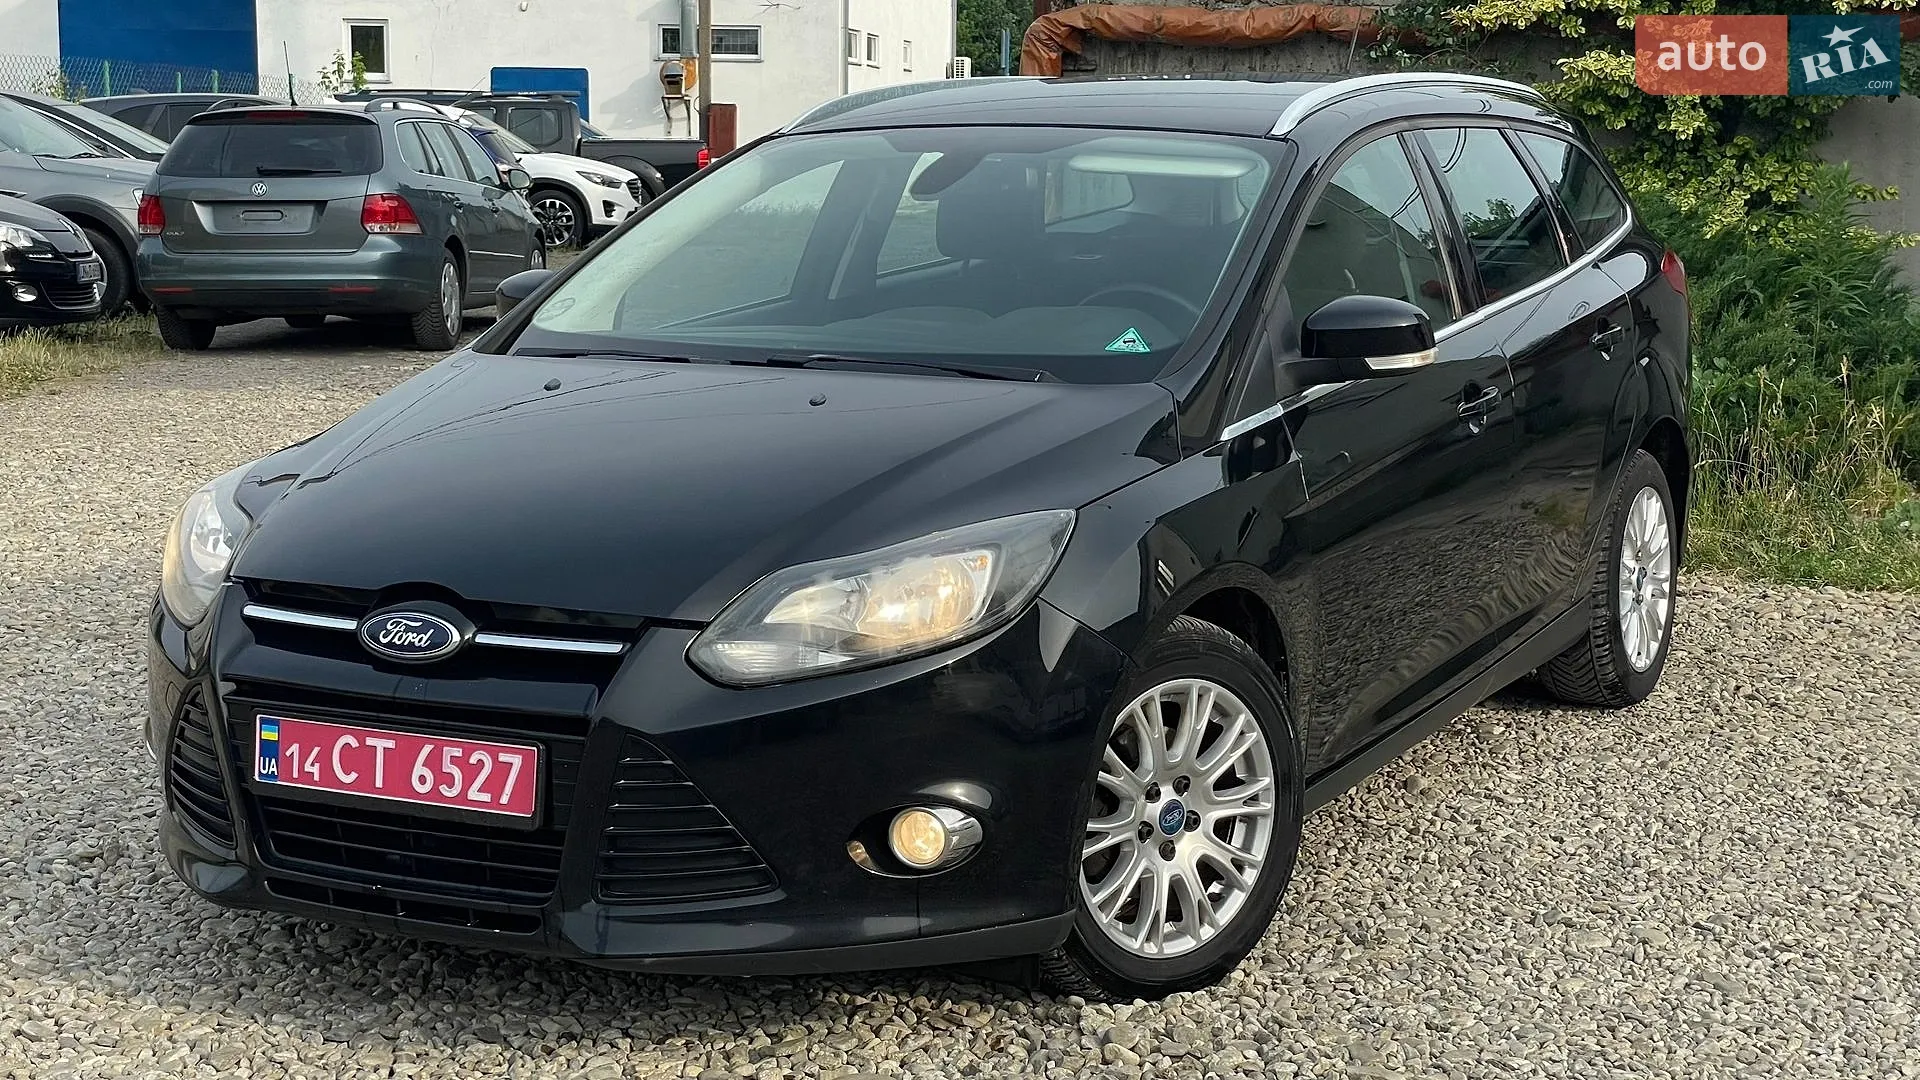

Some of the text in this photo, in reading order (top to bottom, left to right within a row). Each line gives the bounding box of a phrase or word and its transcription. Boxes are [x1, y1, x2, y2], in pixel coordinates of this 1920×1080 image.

[379, 618, 434, 648] Ford
[260, 757, 278, 775] UA
[285, 734, 523, 805] 14 CT 6527
